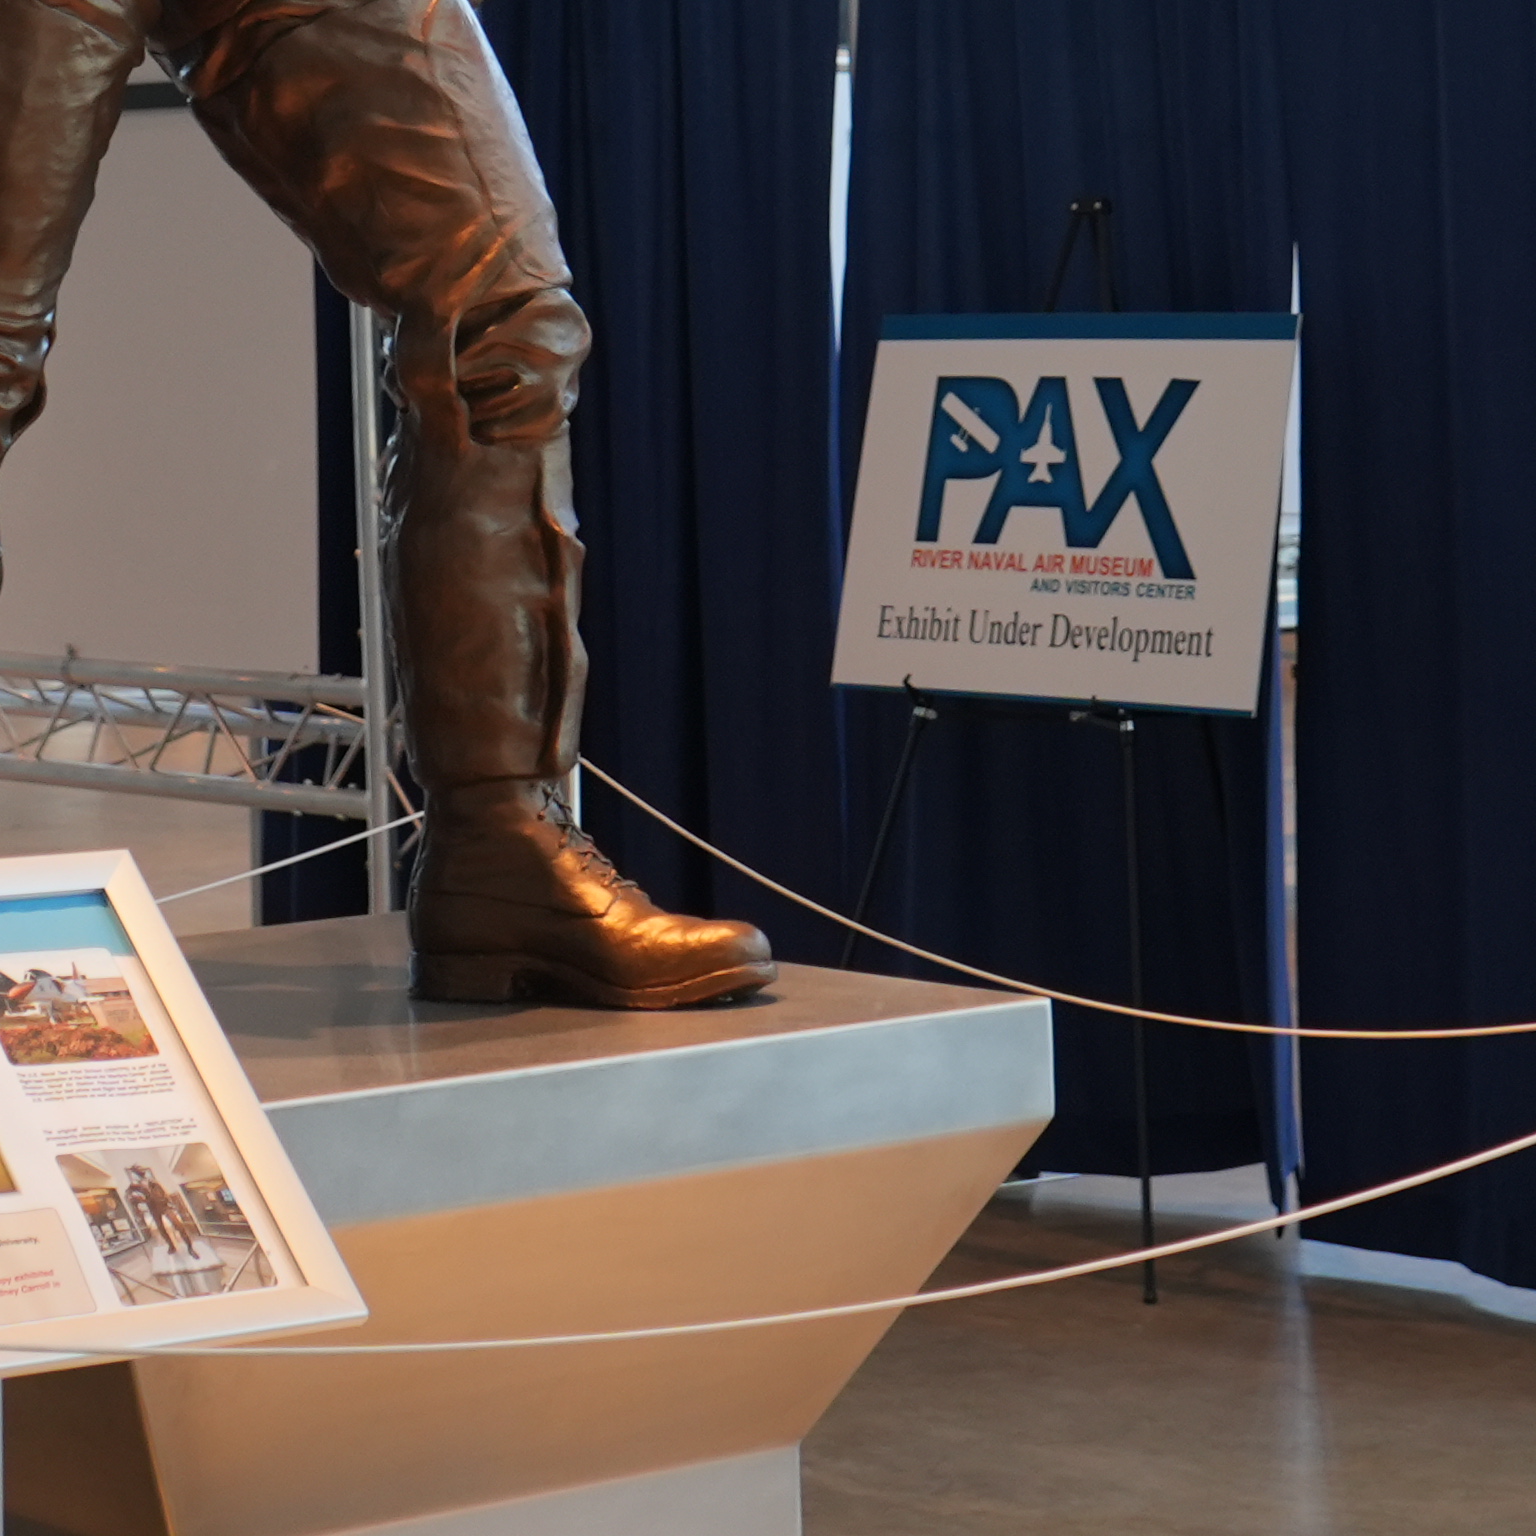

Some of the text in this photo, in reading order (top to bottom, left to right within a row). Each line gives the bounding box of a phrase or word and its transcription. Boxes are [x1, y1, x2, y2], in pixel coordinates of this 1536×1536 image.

[916, 376, 1201, 579] PAX
[910, 549, 1154, 577] RIVER NAVAL AIR MUSEUM
[1030, 578, 1196, 600] AND VISITORS CENTER
[877, 604, 1214, 663] Exhibit Under Development
